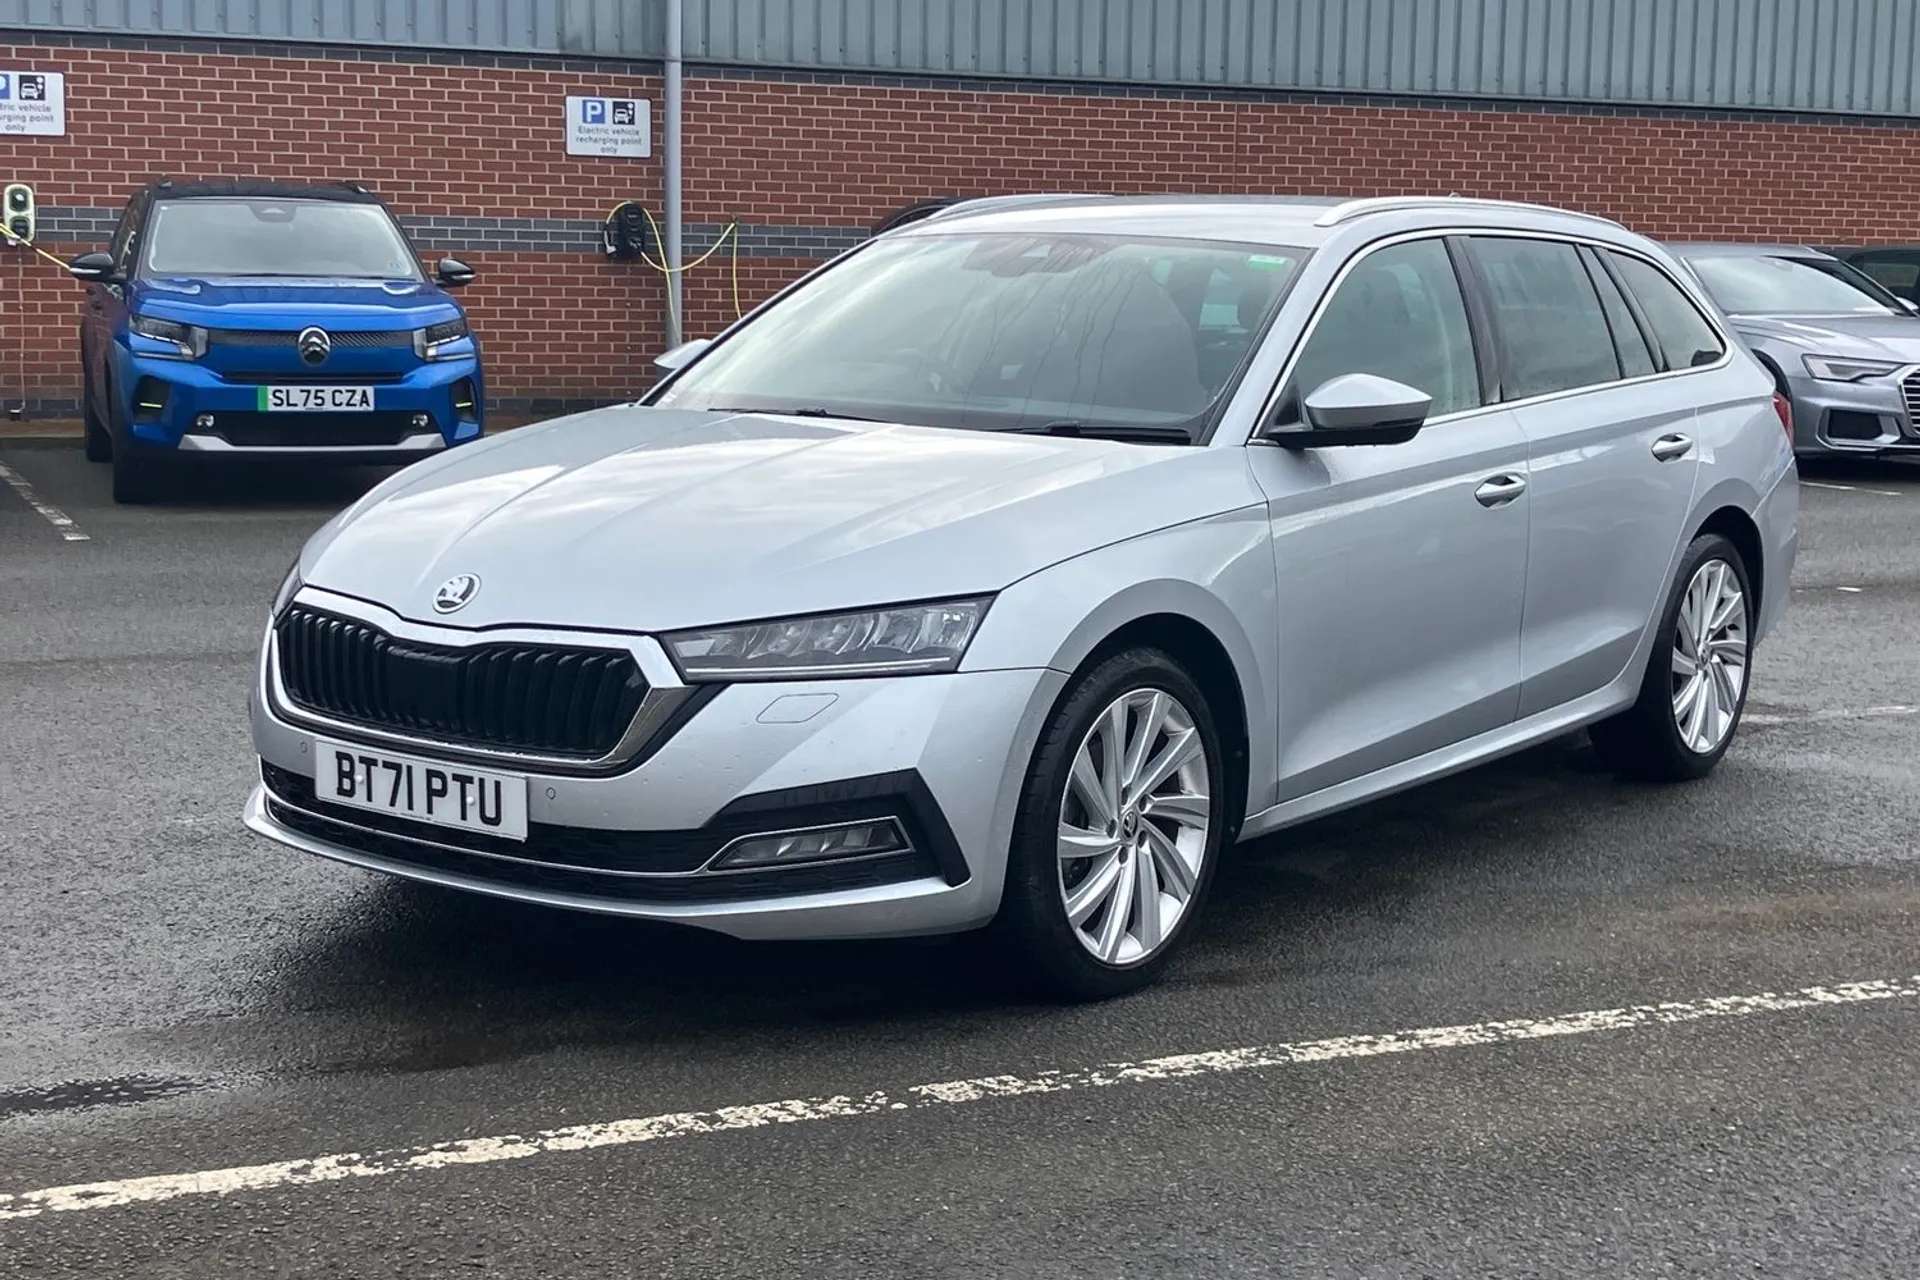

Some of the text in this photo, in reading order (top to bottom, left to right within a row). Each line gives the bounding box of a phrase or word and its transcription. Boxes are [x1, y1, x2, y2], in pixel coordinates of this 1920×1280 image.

[586, 102, 602, 122] P
[578, 126, 639, 136] Electric vehicle
[576, 136, 618, 146] recharging
[272, 389, 371, 407] SL75 CZA
[335, 751, 502, 826] BT71 PTU
